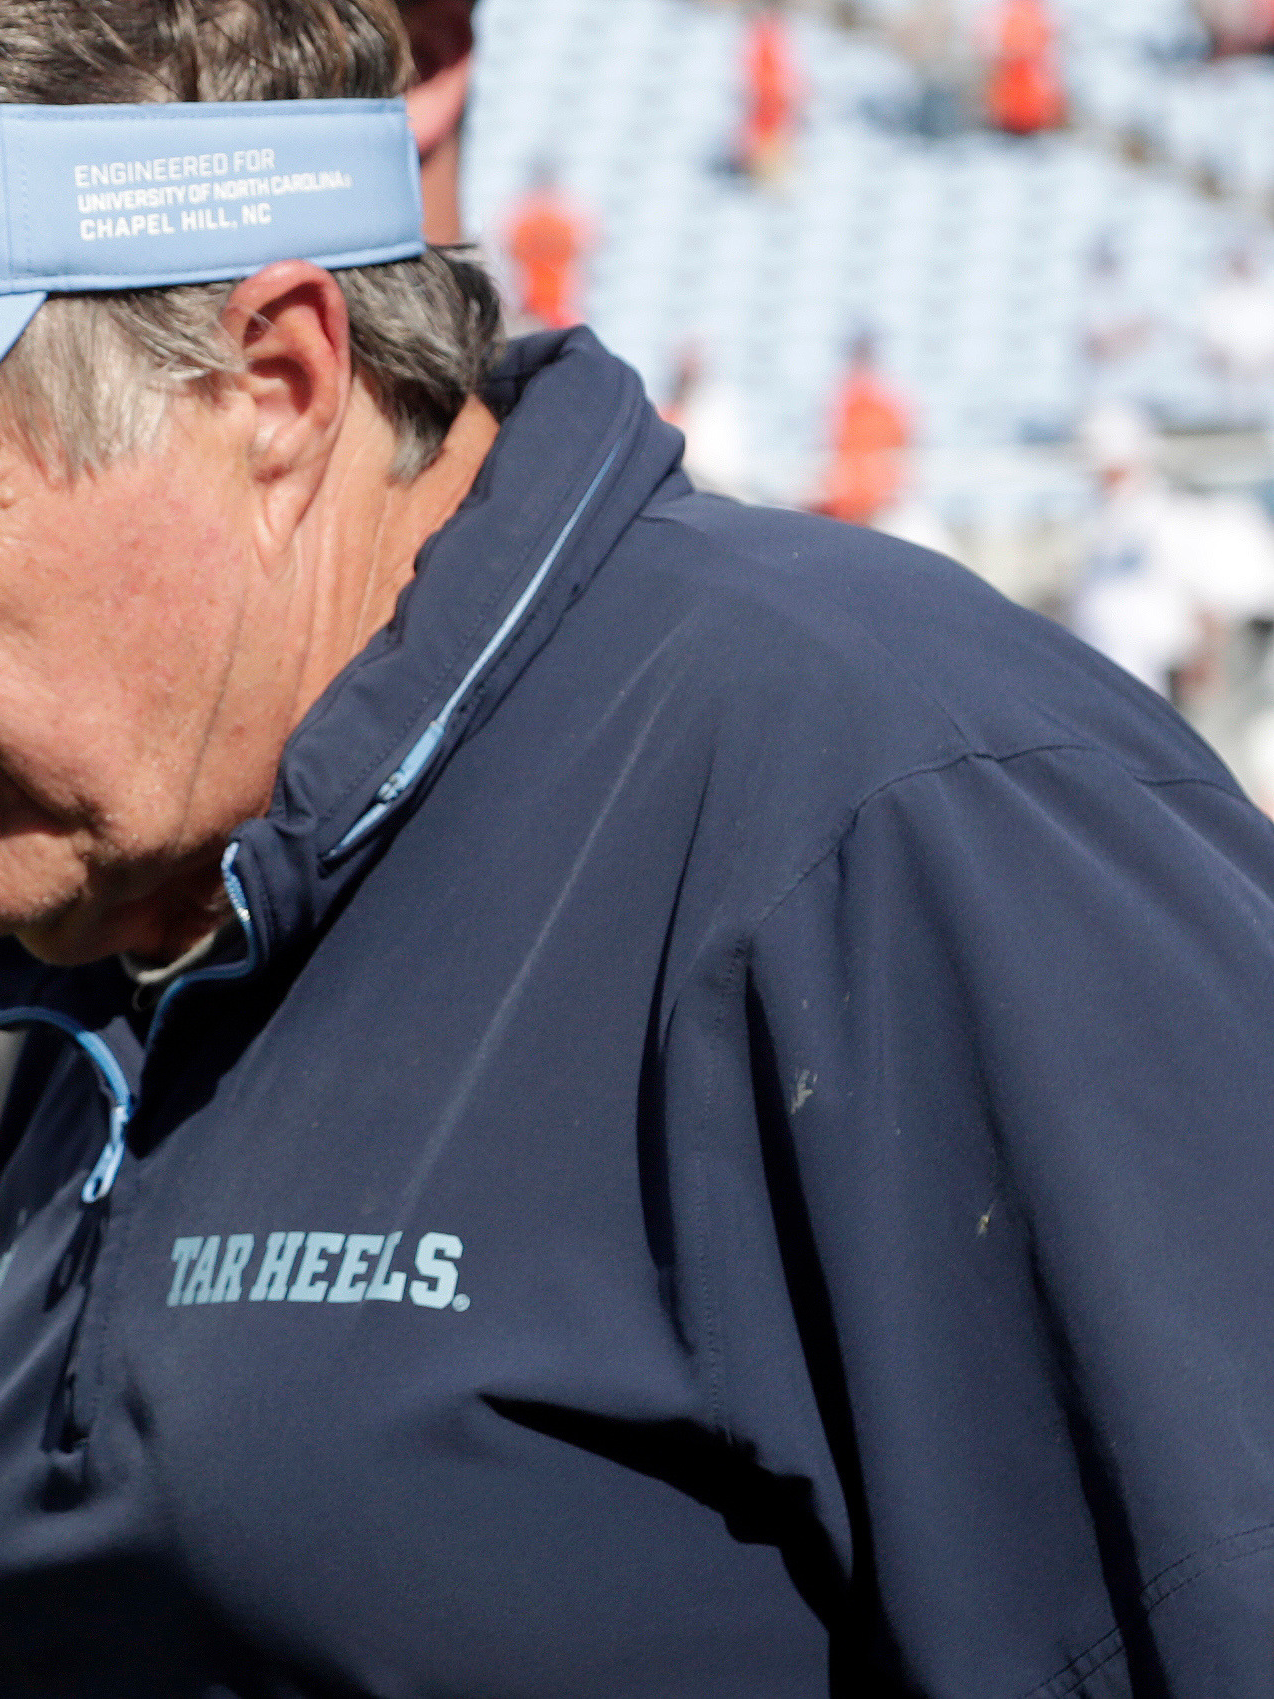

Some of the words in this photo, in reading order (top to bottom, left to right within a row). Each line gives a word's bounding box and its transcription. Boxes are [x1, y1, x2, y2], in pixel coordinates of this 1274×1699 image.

[75, 152, 229, 188] ENGINEERED
[232, 148, 276, 173] FOR
[76, 184, 188, 214] UNIVERSITY
[187, 182, 212, 204] OF
[213, 177, 272, 201] NORTH
[79, 212, 176, 241] CHAPEL
[240, 202, 273, 225] NC
[166, 1232, 255, 1308] TAR
